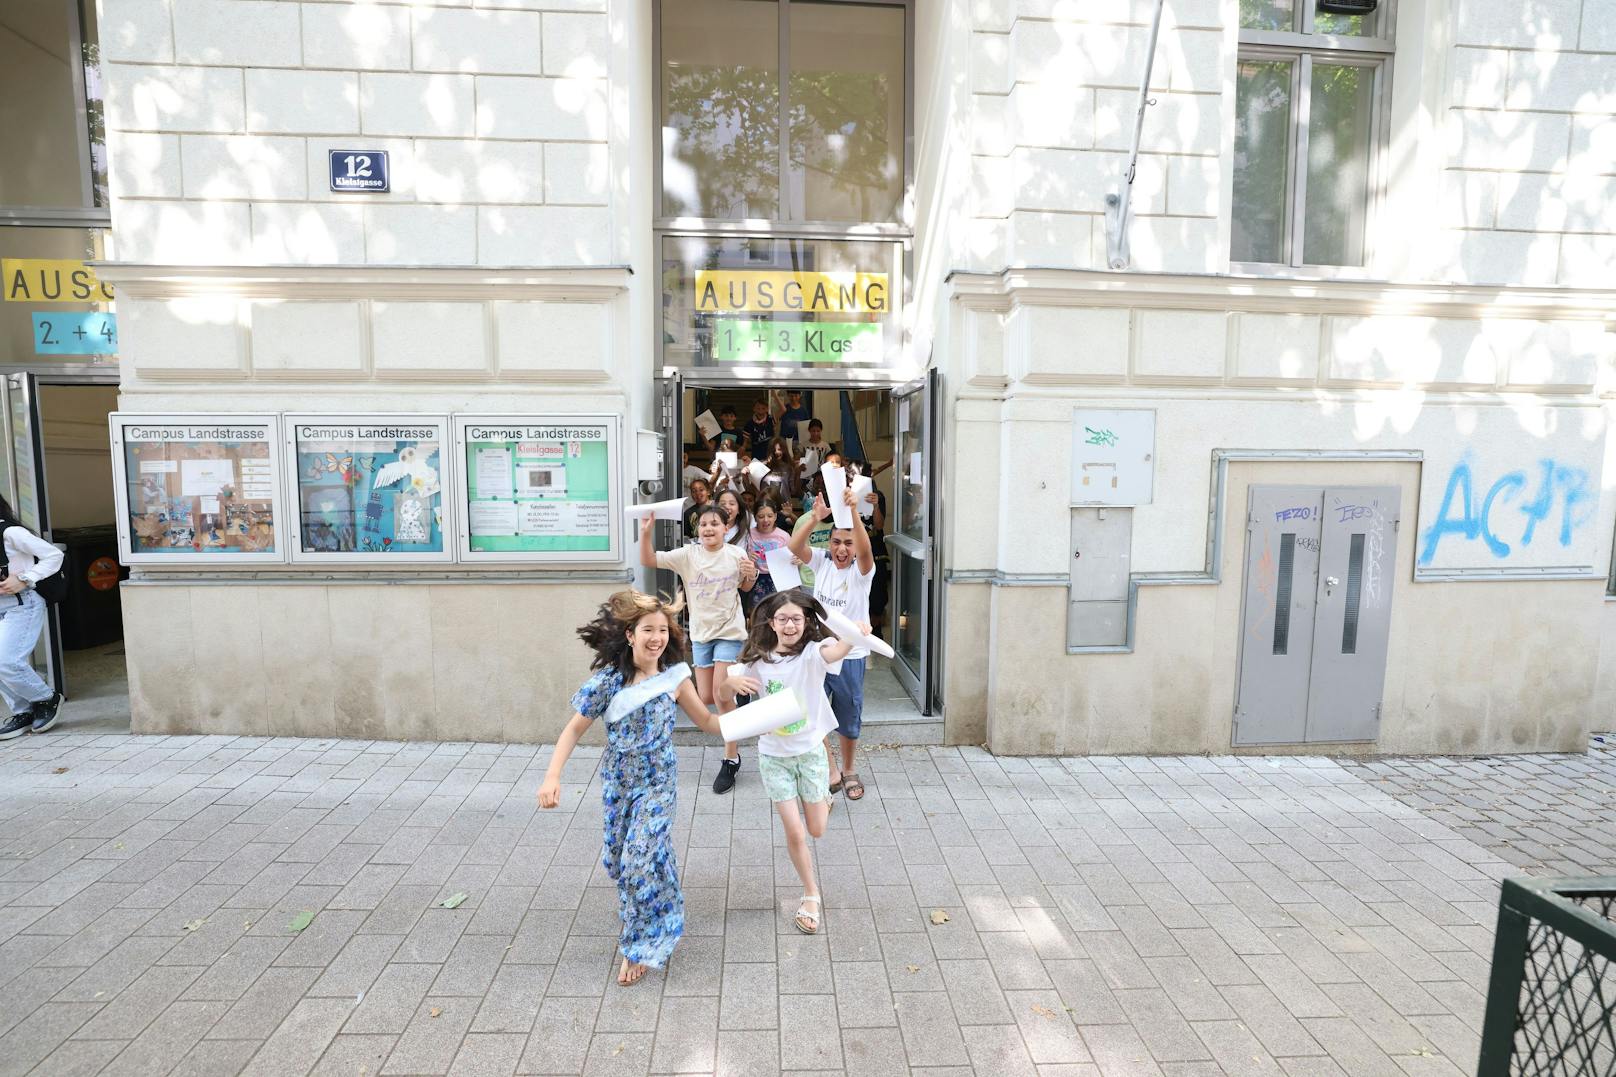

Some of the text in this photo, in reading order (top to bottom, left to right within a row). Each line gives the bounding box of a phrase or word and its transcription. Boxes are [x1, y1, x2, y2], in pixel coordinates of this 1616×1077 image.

[344, 155, 372, 177] 12
[700, 280, 885, 311] AUSGANG
[39, 320, 60, 345] 2.
[723, 329, 741, 352] 1.
[778, 330, 796, 352] 3.
[131, 427, 265, 441] Campus Landstrasse
[302, 427, 433, 440] Campus Landstrasse
[471, 427, 601, 441] Campus Landstrasse
